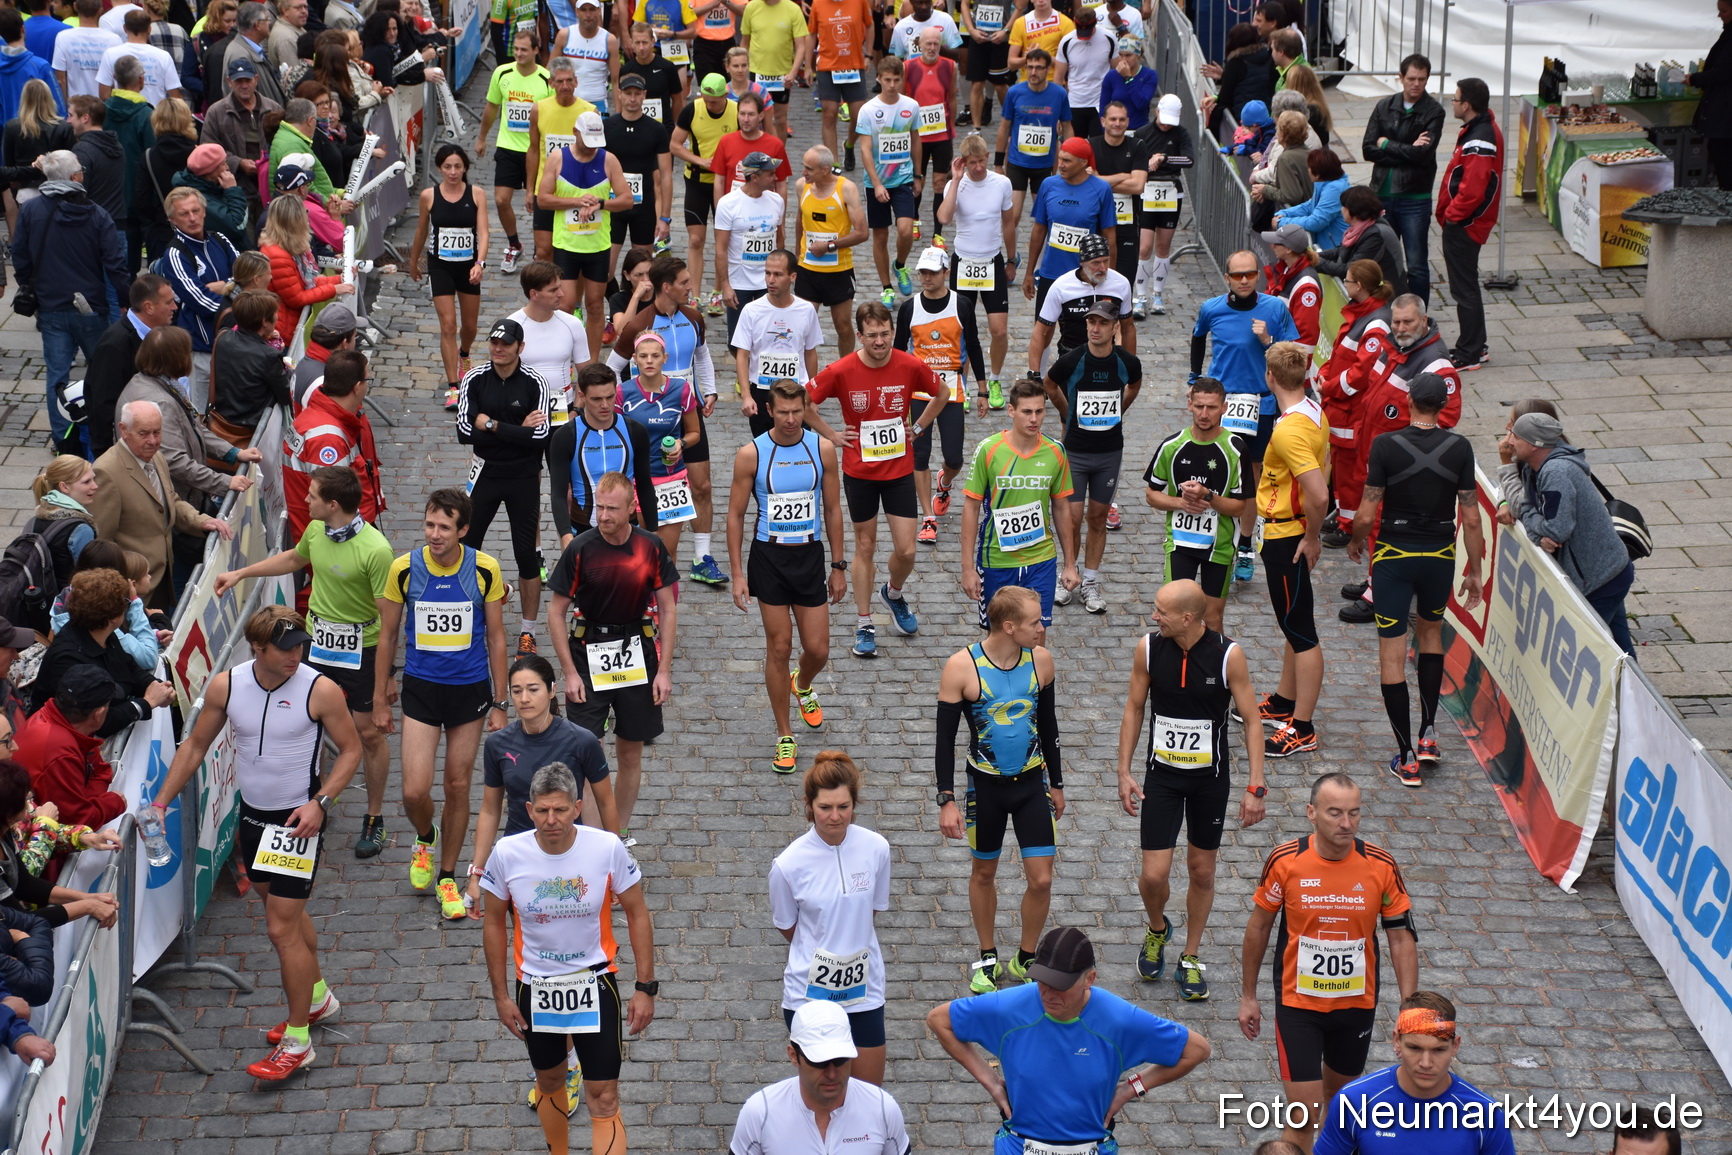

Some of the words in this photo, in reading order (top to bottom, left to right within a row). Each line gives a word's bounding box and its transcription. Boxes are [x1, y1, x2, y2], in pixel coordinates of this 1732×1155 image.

[707, 9, 729, 20] 2087
[979, 10, 1001, 22] 2617
[1026, 32, 1042, 40] MAX
[1044, 27, 1062, 36] BÖGL
[563, 47, 609, 59] cocoon
[670, 44, 681, 55] 59
[508, 90, 534, 99] Müller
[922, 112, 941, 124] 189
[1025, 133, 1046, 145] 206
[883, 140, 909, 153] 2648
[347, 173, 359, 195] BMW
[354, 138, 373, 173] Laufsport
[1154, 189, 1167, 201] 31
[442, 235, 472, 249] 2703
[1058, 231, 1081, 247] 537
[746, 239, 773, 253] 2018
[965, 265, 988, 278] 383
[762, 361, 796, 377] 2446
[1082, 401, 1117, 416] 2374
[1227, 402, 1259, 420] 2675
[1232, 420, 1253, 429] Markus
[870, 428, 898, 446] 160
[873, 447, 897, 456] Michael
[996, 476, 1052, 490] BOCK
[1190, 475, 1207, 485] DAV
[665, 510, 680, 518] Silke
[773, 502, 810, 521] 2321
[1011, 507, 1034, 516] Neumarkt
[778, 523, 808, 532] Wolfgang
[1000, 512, 1040, 536] 2826
[1175, 512, 1212, 533] 3014
[1013, 534, 1033, 544] Lukas
[427, 614, 463, 633] 539
[316, 629, 358, 651] 3049
[600, 649, 634, 672] 342
[1157, 720, 1173, 728] PARTL
[1165, 731, 1201, 751] 372
[1168, 753, 1197, 762] Thomas
[270, 830, 309, 856] 530
[262, 852, 305, 870] URBEL
[1618, 756, 1732, 960] slac
[1300, 878, 1321, 887] DAK
[1301, 894, 1365, 904] SportScheck
[545, 902, 591, 910] FRÄNKISCHE
[1300, 942, 1322, 952] PARTL
[540, 951, 586, 962] SIEMENS
[814, 953, 835, 966] PARTL
[837, 956, 861, 967] Neumarkt
[1312, 954, 1354, 977] 205
[815, 963, 864, 988] 2483
[532, 980, 553, 988] PARTL
[1313, 980, 1350, 990] Berthold
[538, 987, 593, 1011] 3004
[828, 992, 848, 1001] Julia
